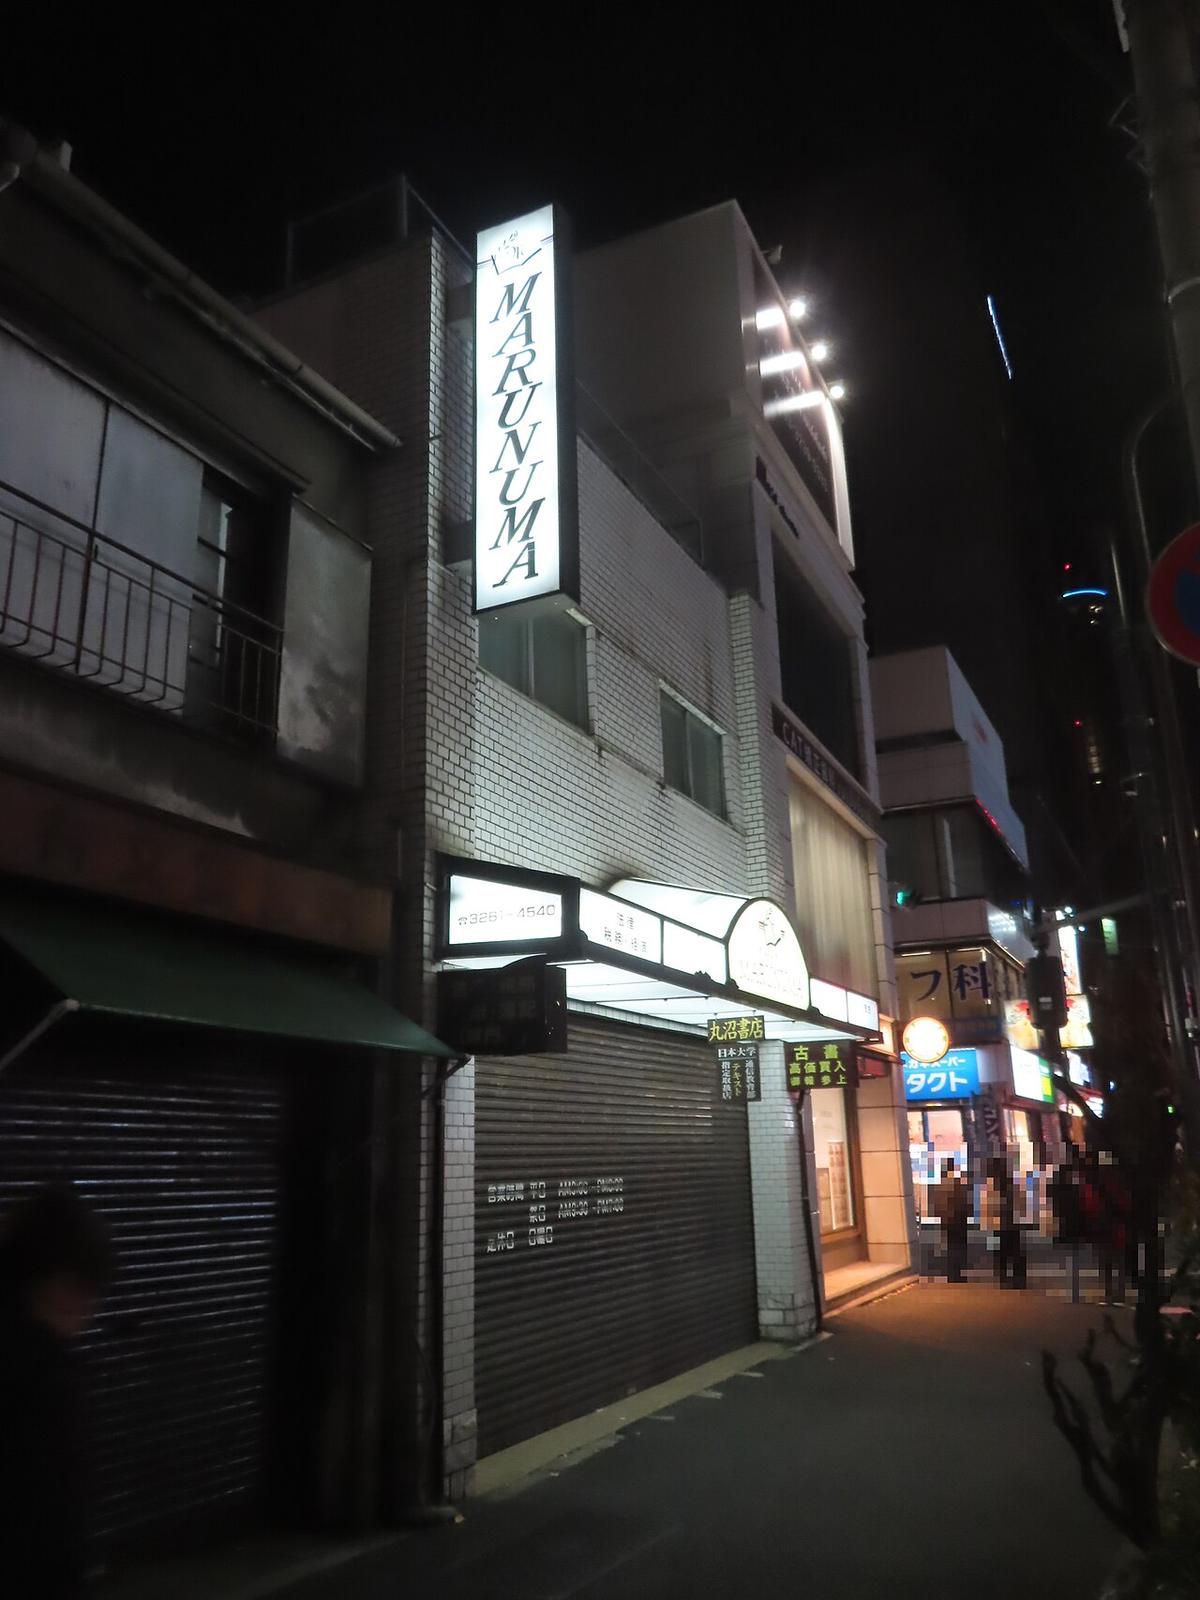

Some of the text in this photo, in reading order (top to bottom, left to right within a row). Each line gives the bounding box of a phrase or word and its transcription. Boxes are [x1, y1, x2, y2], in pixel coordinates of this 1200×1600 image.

[489, 271, 547, 588] MARUNUMA
[709, 1017, 764, 1042] 丸沼書店
[718, 1046, 757, 1058] 日本大学
[732, 1062, 742, 1097] テキスト
[789, 1060, 847, 1075] 高価買入
